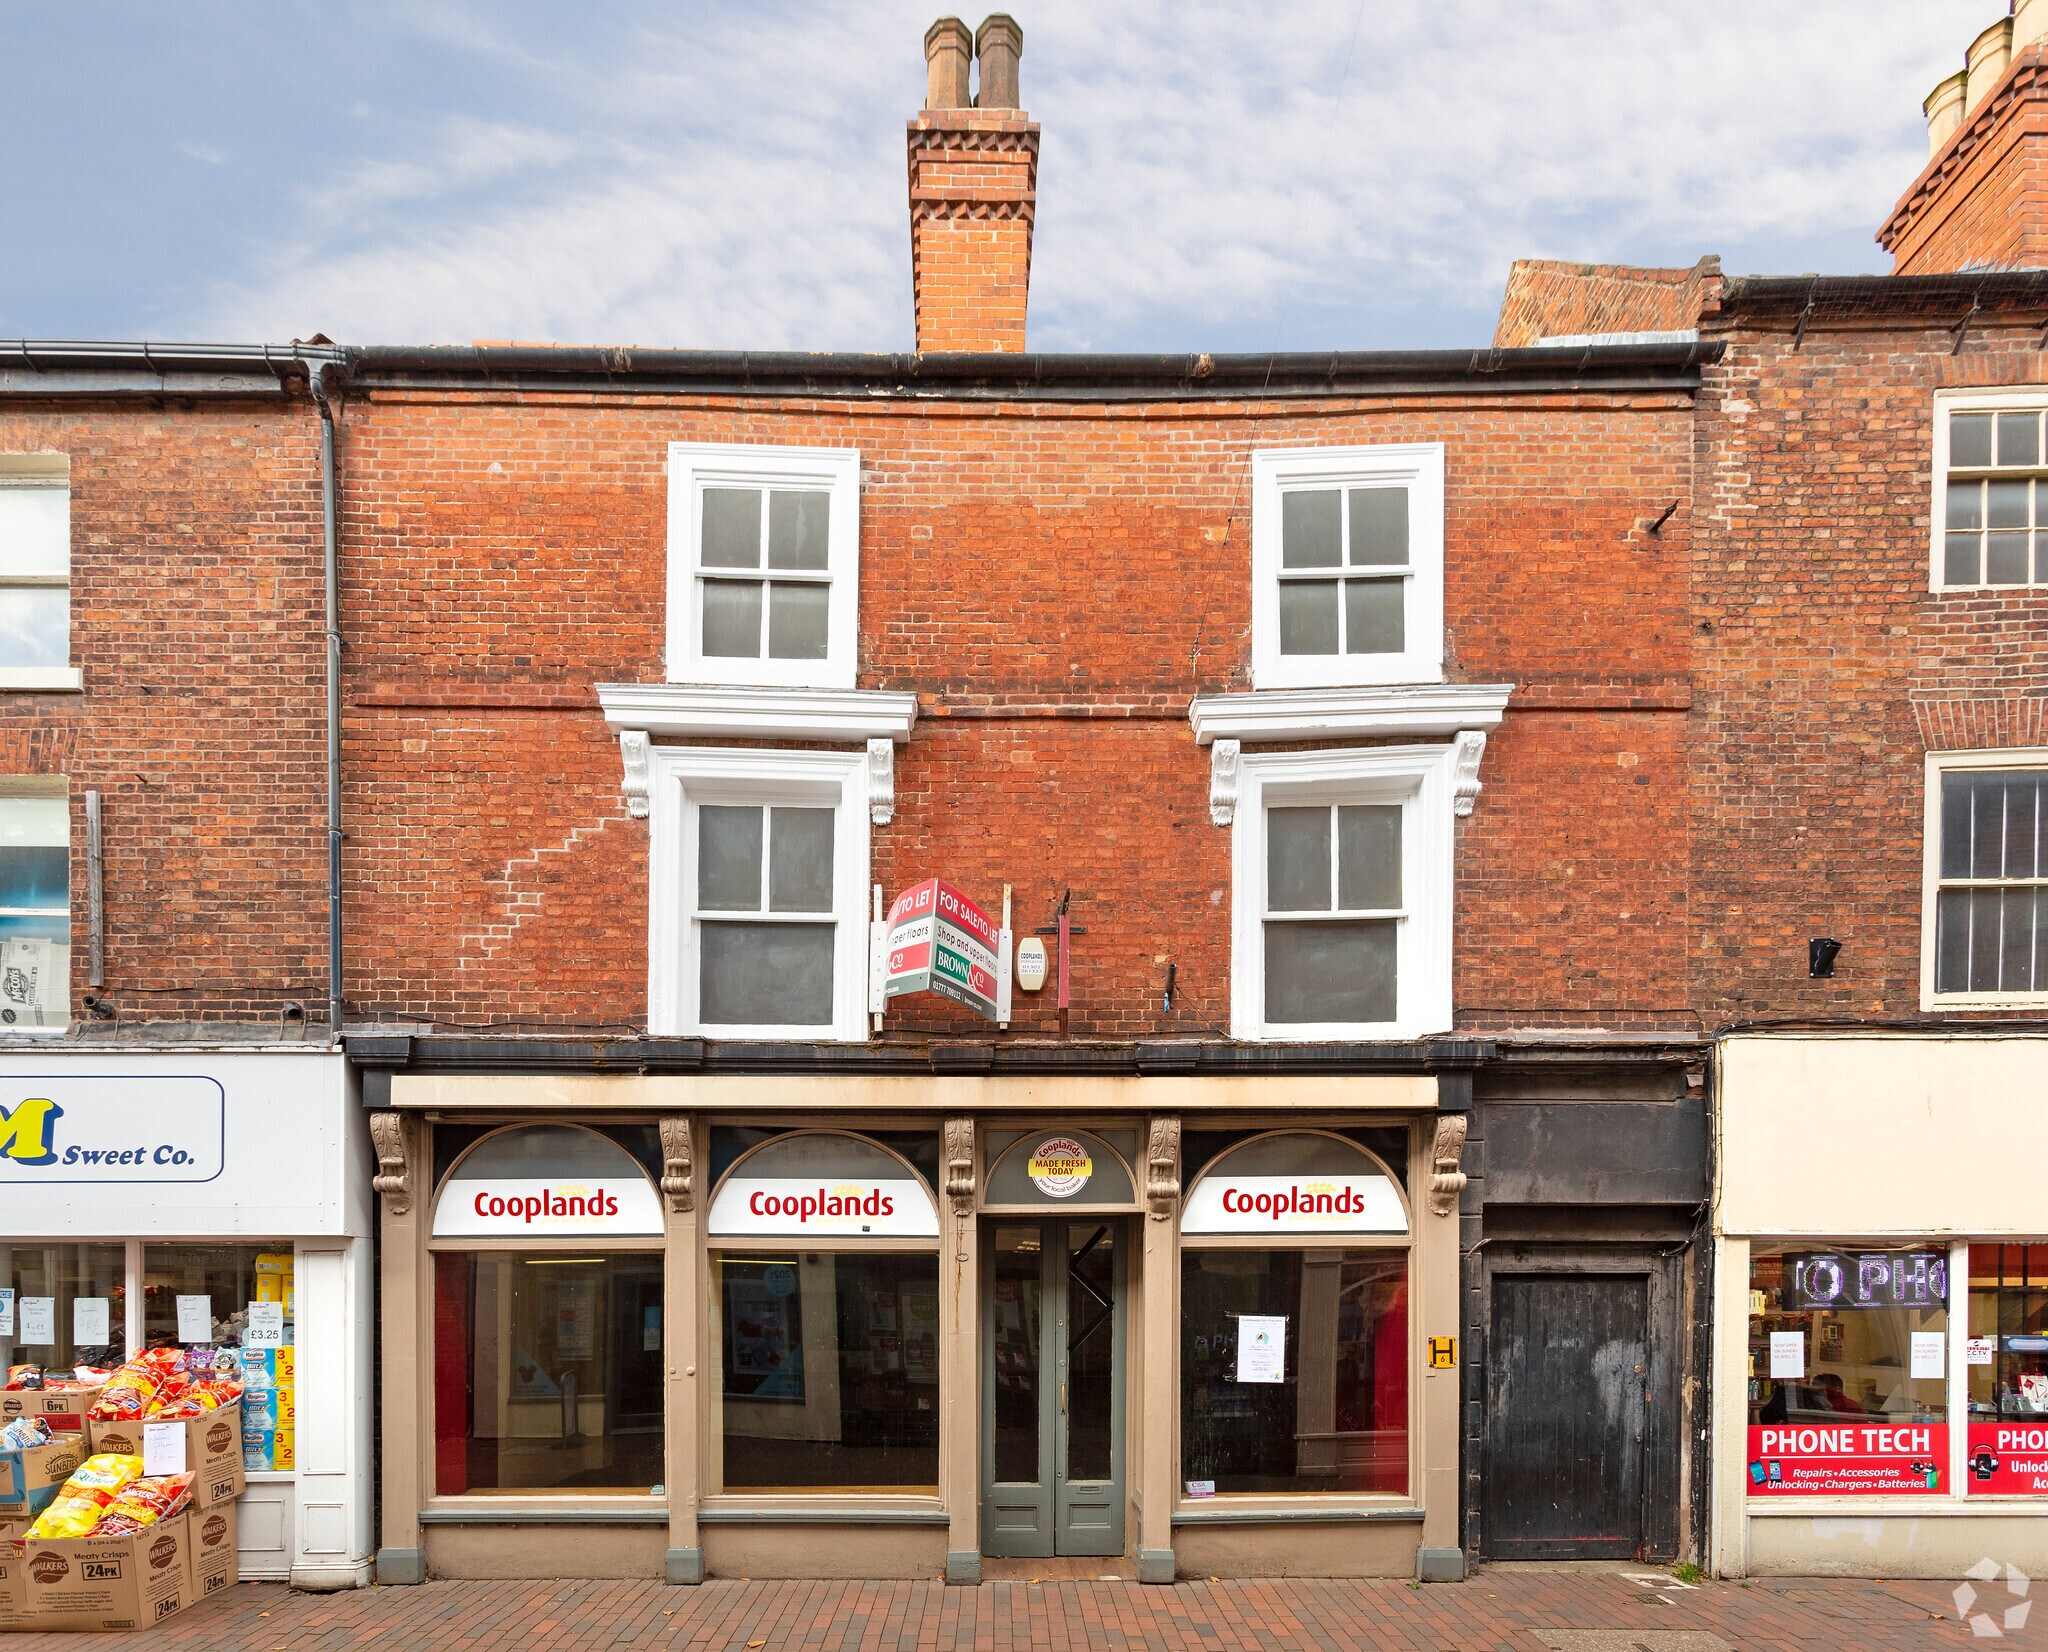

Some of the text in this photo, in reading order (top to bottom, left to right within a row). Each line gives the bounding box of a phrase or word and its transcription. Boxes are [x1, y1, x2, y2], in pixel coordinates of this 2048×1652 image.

[916, 889, 931, 908] LET
[940, 890, 998, 945] FOR SALE/TO LET
[907, 925, 929, 940] floors
[937, 925, 955, 946] Shop
[956, 939, 969, 952] and
[969, 944, 985, 963] upper
[62, 1145, 147, 1165] Sweet
[153, 1144, 195, 1165] Co.
[1038, 1140, 1082, 1158] Cooplands
[1035, 1160, 1086, 1168] MADE FRESH
[1038, 1178, 1052, 1190] your
[1066, 1178, 1081, 1191] baker
[474, 1188, 619, 1223] Cooplands
[749, 1188, 894, 1223] Cooplands
[1222, 1186, 1365, 1220] Cooplands
[1796, 1260, 1844, 1301] O
[251, 1329, 279, 1340] £3.25
[277, 1350, 285, 1359] 3
[1432, 1339, 1453, 1364] H
[285, 1366, 294, 1375] 2
[279, 1392, 287, 1401] 3
[47, 1401, 64, 1411] 6PK
[287, 1407, 294, 1417] 2
[206, 1430, 232, 1444] WALKERS
[276, 1433, 284, 1443] 3
[1761, 1428, 1930, 1453] PHONE TECH
[100, 1442, 133, 1453] WALKERS
[283, 1449, 292, 1458] 2
[206, 1451, 236, 1464] Meaty Crisps
[45, 1457, 79, 1474] SUNBITES
[1793, 1468, 1900, 1479] Repairs Accessories
[1767, 1479, 1926, 1491] Unlocking Chargers Batteries
[2033, 1476, 2048, 1489] Ac
[214, 1483, 232, 1498] 24PK
[201, 1522, 227, 1537] WALKERS
[149, 1542, 177, 1560] WALKERS
[216, 1542, 231, 1552] Crisps
[101, 1551, 130, 1559] Crisps
[31, 1561, 68, 1572] WALKERS
[86, 1564, 118, 1578] 24PK
[149, 1563, 181, 1582] Meaty Crisps
[206, 1576, 225, 1591] 24PK
[158, 1599, 178, 1617] 24PK
